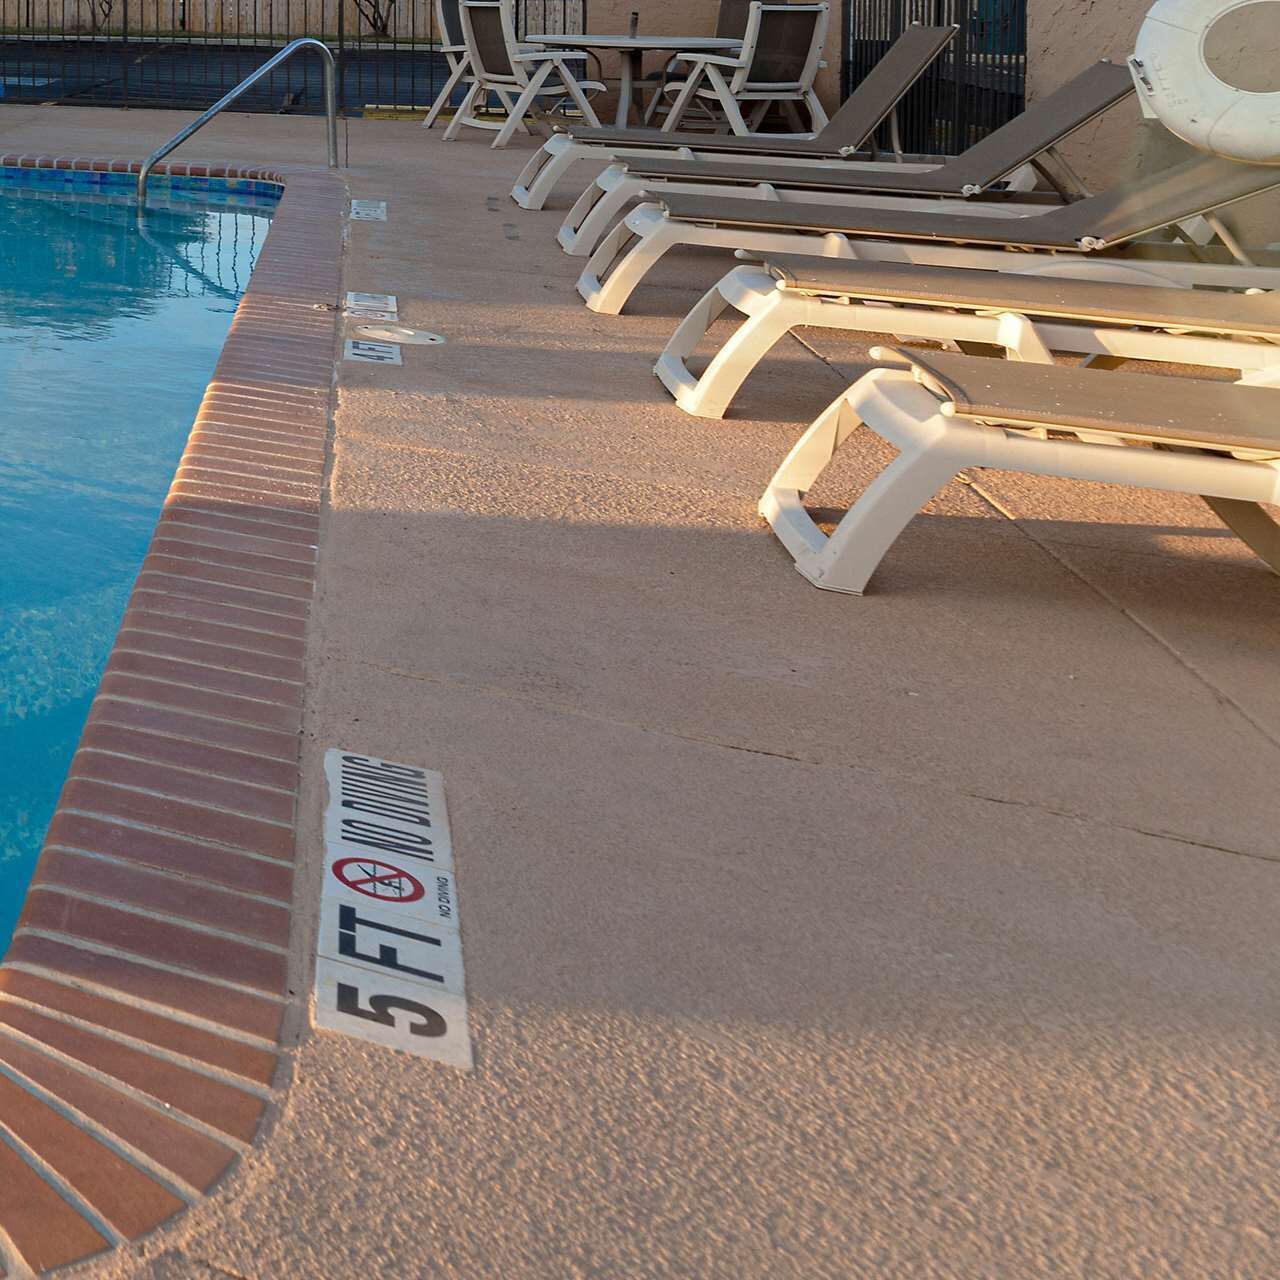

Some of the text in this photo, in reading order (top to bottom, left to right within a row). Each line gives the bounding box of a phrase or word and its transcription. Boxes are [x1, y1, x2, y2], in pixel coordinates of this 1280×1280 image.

[341, 755, 435, 863] NO DIVING
[436, 876, 452, 919] NO DIVING
[337, 904, 447, 1038] 5 FT
